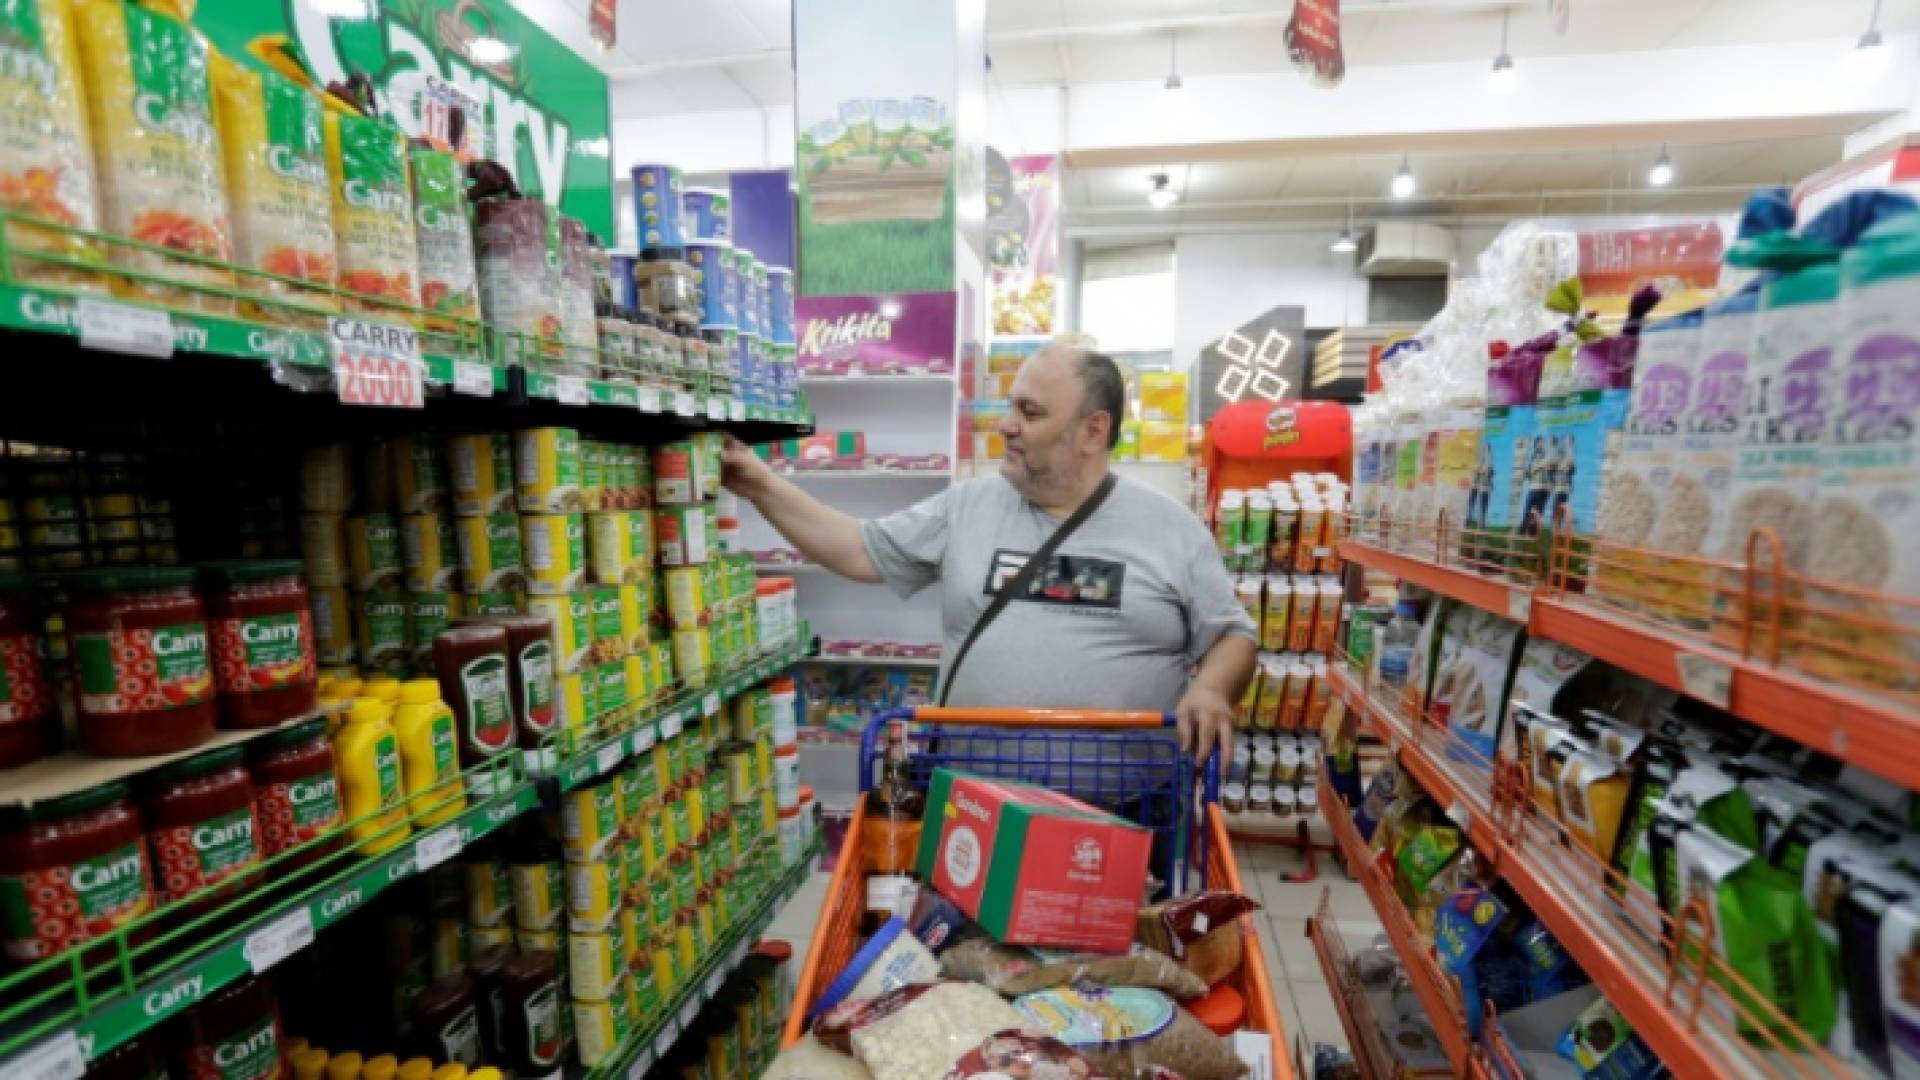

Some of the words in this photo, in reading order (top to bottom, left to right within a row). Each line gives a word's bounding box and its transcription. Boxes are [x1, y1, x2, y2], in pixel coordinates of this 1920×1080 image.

[334, 318, 416, 351] CARRY
[340, 352, 413, 406] 2000
[240, 623, 299, 644] Carry
[288, 776, 337, 804] Carry
[191, 818, 252, 851] Carry
[70, 852, 141, 892] Carry
[321, 887, 363, 918] Carry
[145, 974, 204, 1016] Carry
[213, 1024, 278, 1068] Carry
